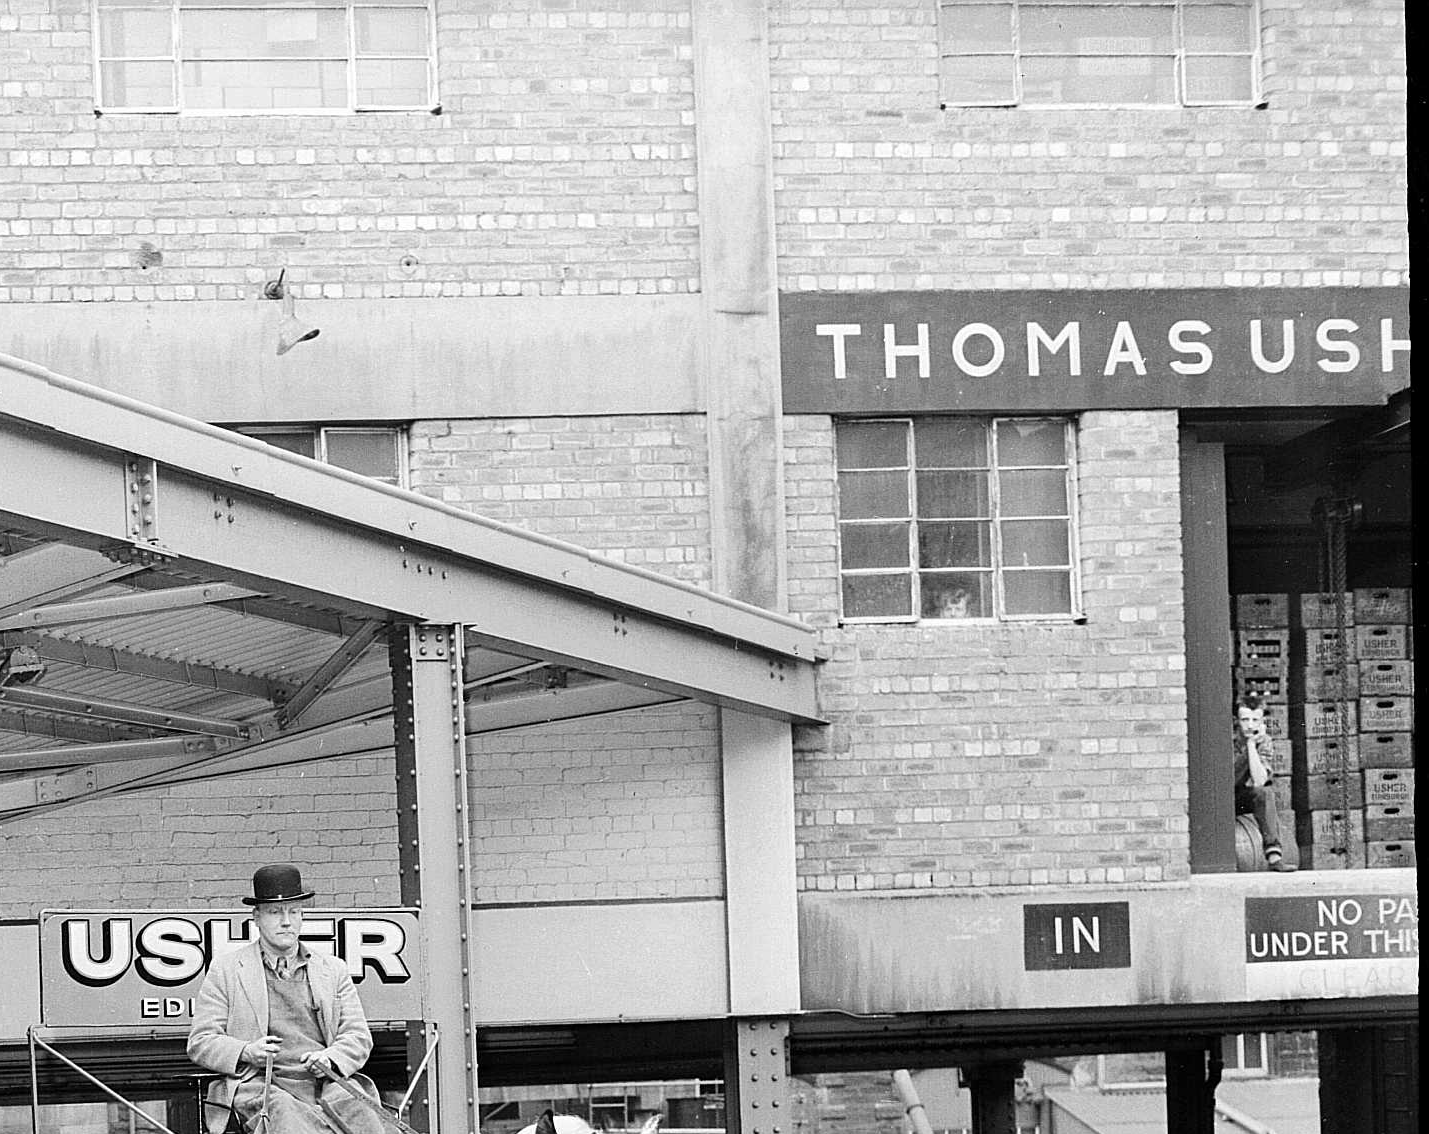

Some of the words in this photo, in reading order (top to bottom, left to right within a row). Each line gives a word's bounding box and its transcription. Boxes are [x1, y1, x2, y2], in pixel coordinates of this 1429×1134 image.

[815, 319, 1214, 380] THOMAS
[1317, 898, 1363, 927] NO
[1054, 916, 1100, 955] IN
[1250, 931, 1349, 958] UNDER
